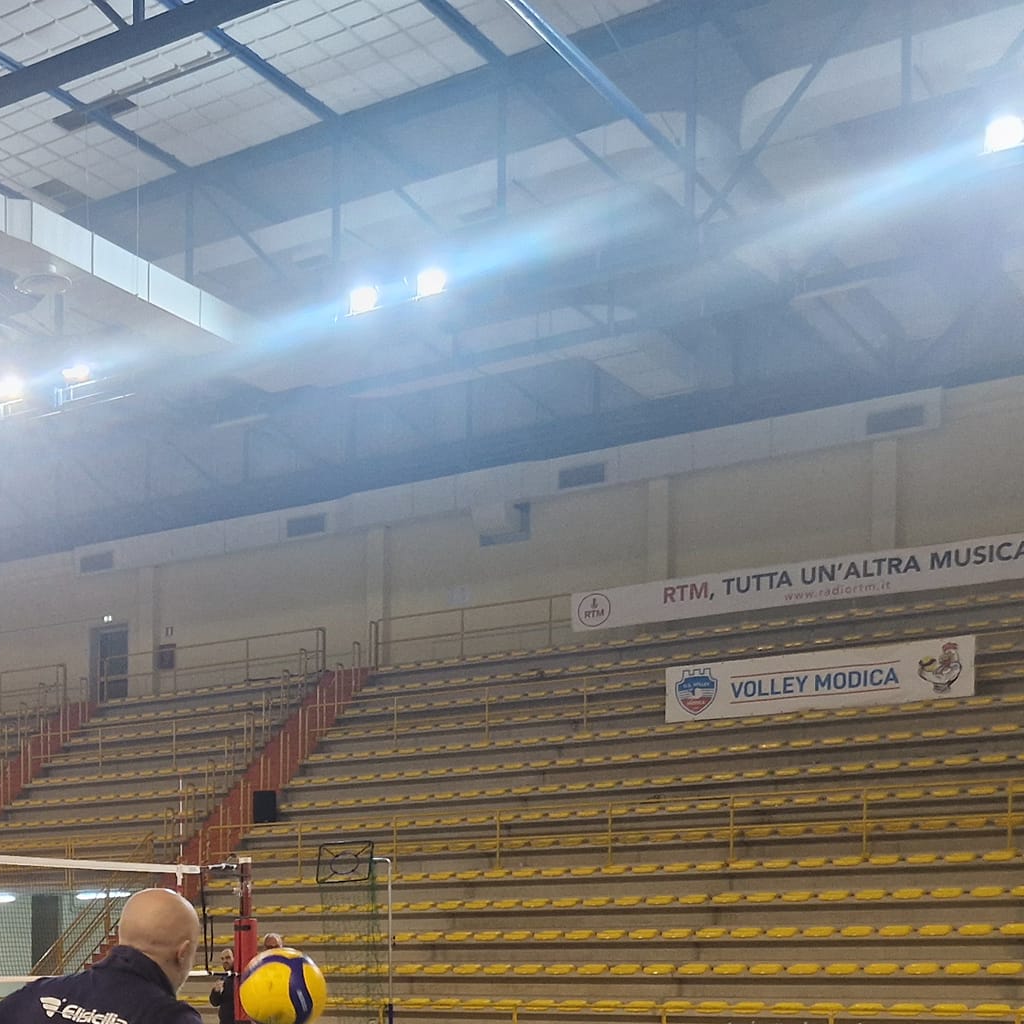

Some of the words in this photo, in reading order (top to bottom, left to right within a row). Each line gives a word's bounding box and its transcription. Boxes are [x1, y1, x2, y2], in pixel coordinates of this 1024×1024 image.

[663, 581, 715, 604] RTM,
[722, 570, 793, 596] TUTTA
[801, 555, 921, 586] UN'ALTRA
[929, 540, 1024, 571] MUSICA
[784, 581, 891, 601] www.radiortm.it
[584, 608, 605, 619] RTM
[731, 675, 808, 699] VOLLEY
[814, 667, 900, 692] MODICA
